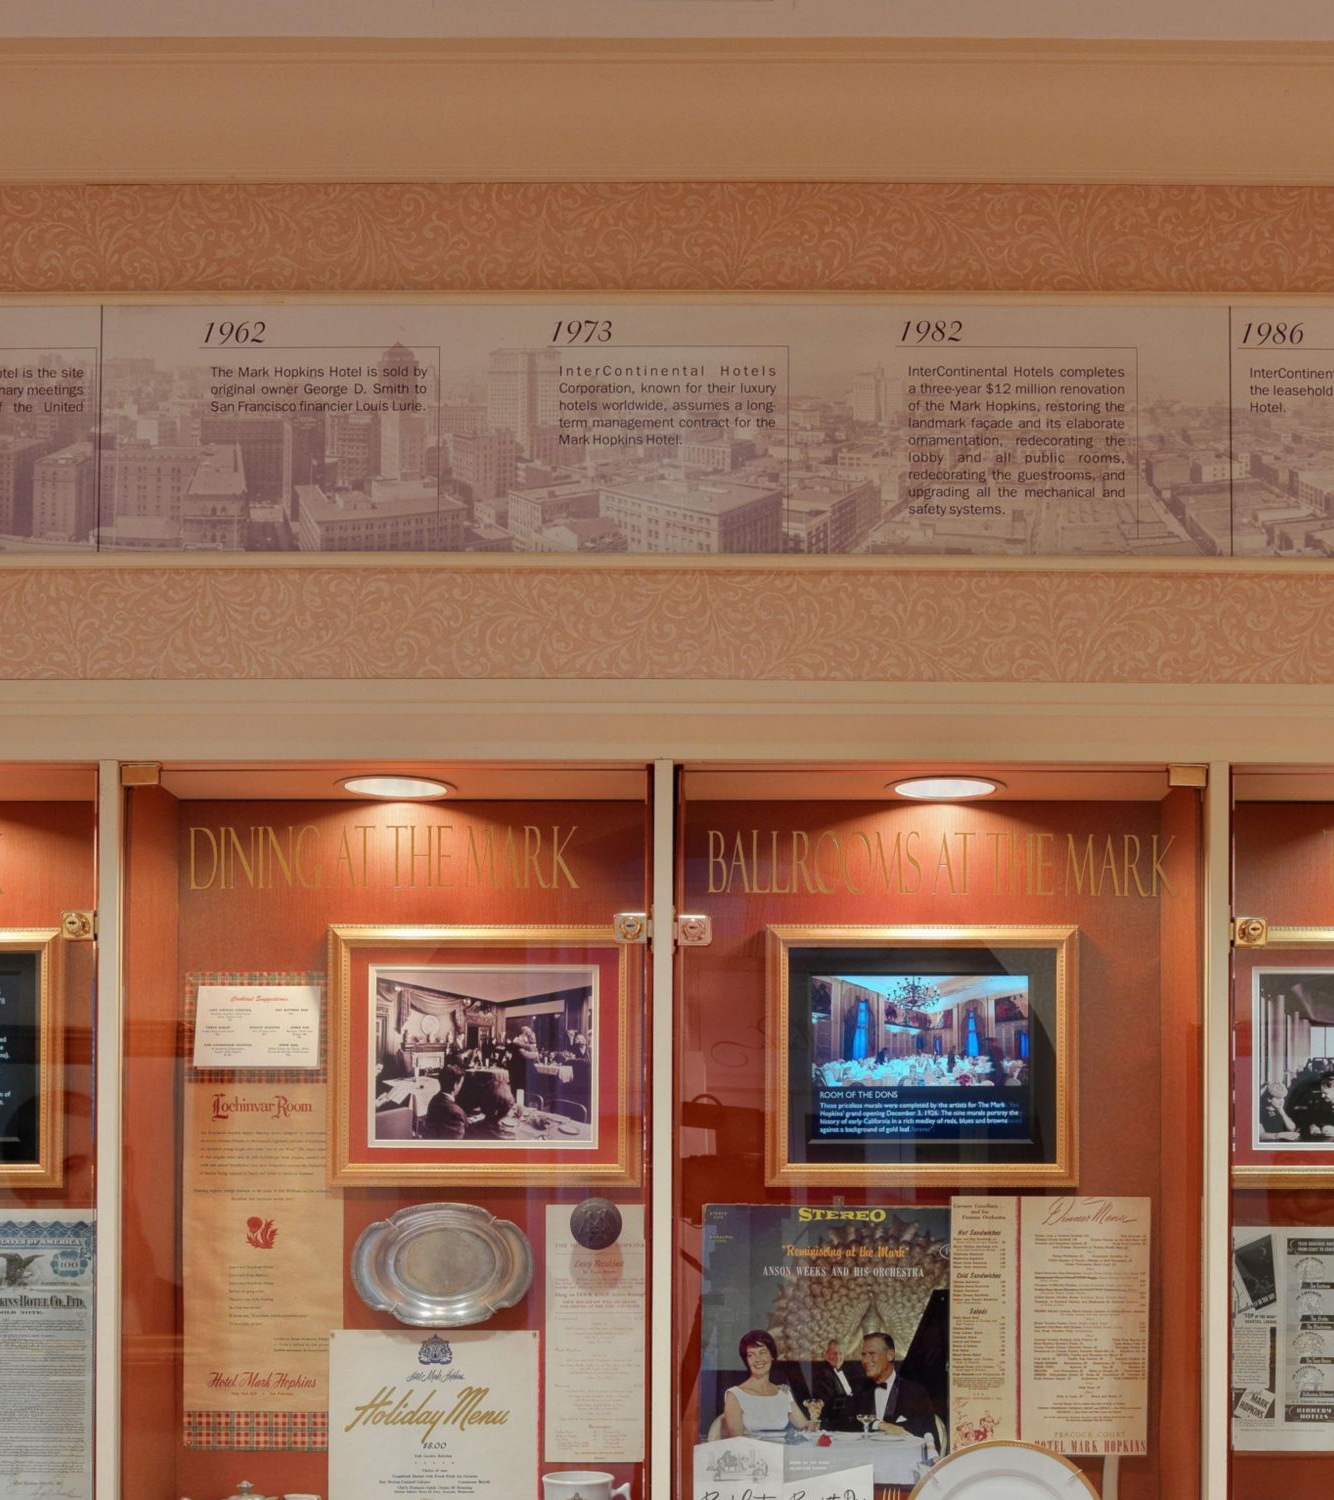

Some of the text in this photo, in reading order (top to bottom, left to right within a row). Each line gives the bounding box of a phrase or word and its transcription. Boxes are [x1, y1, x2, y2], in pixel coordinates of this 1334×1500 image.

[203, 321, 267, 345] 1962
[552, 320, 612, 344] 1973
[900, 320, 963, 343] 1982
[1242, 322, 1305, 346] 1986
[23, 368, 32, 378] is
[38, 368, 56, 378] the
[61, 368, 84, 378] site
[211, 366, 427, 379] The Mark Hopkins Hotel is sold by
[27, 385, 84, 397] meetings
[1250, 386, 1268, 395] the
[1273, 386, 1333, 396] leasehold
[13, 402, 32, 412] the
[44, 402, 84, 412] United
[1250, 403, 1286, 413] Hotel.
[189, 825, 579, 890] DINING AT THE MARK
[707, 830, 1177, 897] BALLROOMS AT THE MARK
[820, 1091, 844, 1099] ROOM
[846, 1091, 856, 1099] OF
[212, 1093, 312, 1121] Lochinvar Room
[798, 1208, 886, 1222] STEREO
[763, 1266, 924, 1278] ANSON WEEKS AND HIS ORCHESTRA
[209, 1371, 316, 1390] Hotel Mark Hopkins
[344, 1386, 510, 1444] Holiday Menu
[1071, 1440, 1098, 1452] MARK
[1104, 1440, 1146, 1452] HOPKINS
